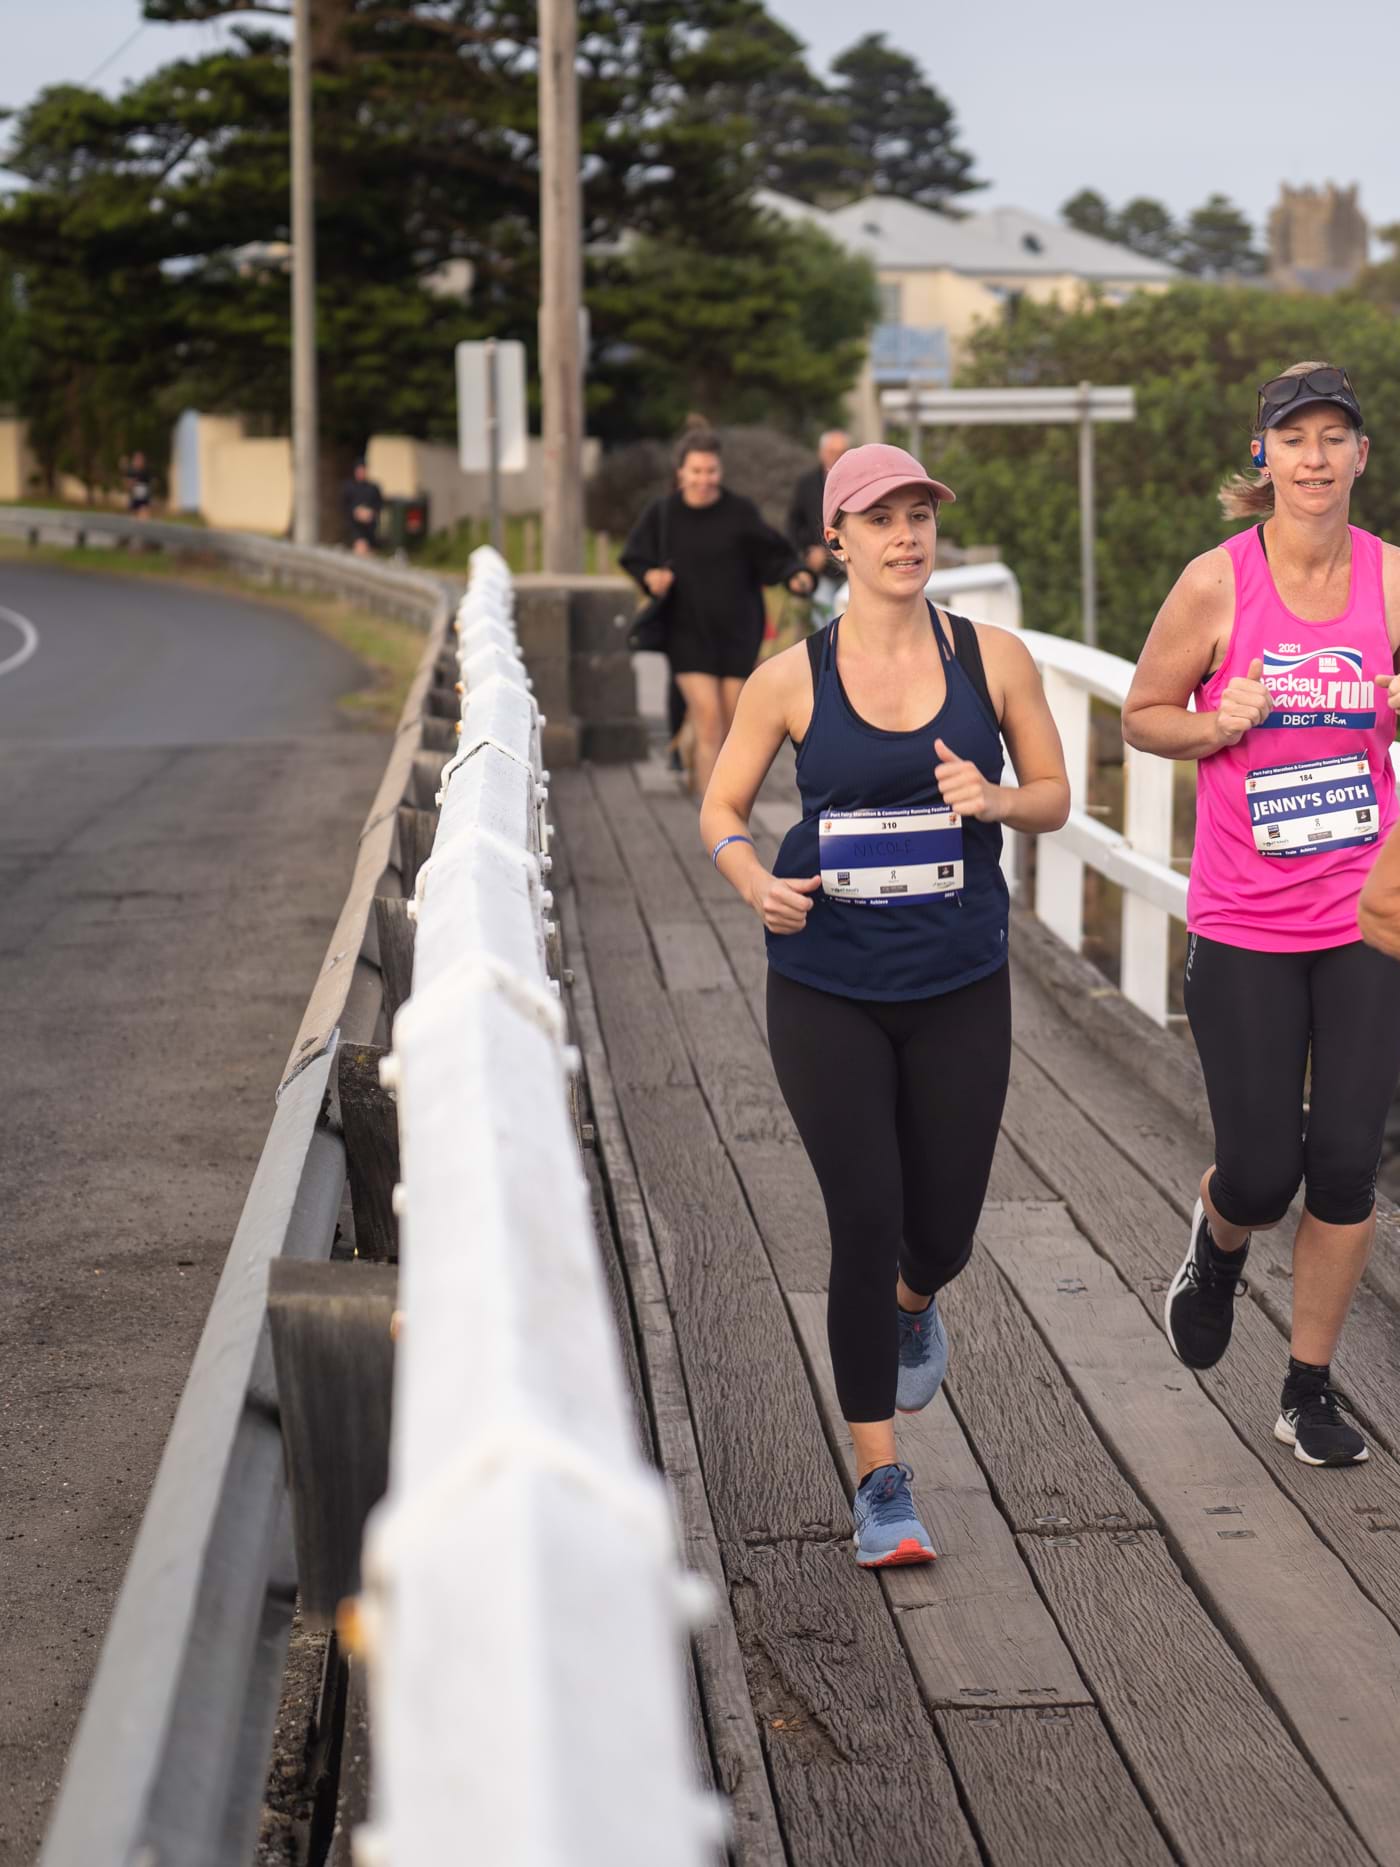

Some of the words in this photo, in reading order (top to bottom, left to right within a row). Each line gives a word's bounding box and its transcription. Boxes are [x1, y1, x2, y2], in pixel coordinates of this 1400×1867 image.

[1278, 643, 1301, 653] 2021
[1327, 680, 1374, 709] run
[1282, 714, 1318, 725] DBCT
[1323, 712, 1347, 725] 8km
[1273, 765, 1294, 774] Marathon
[1298, 761, 1322, 770] Community
[1322, 758, 1340, 766] Running
[1299, 774, 1313, 782] 184
[1252, 795, 1323, 821] JENNY'S
[1326, 784, 1369, 804] 60TH
[910, 807, 931, 815] Running
[882, 822, 897, 830] 310
